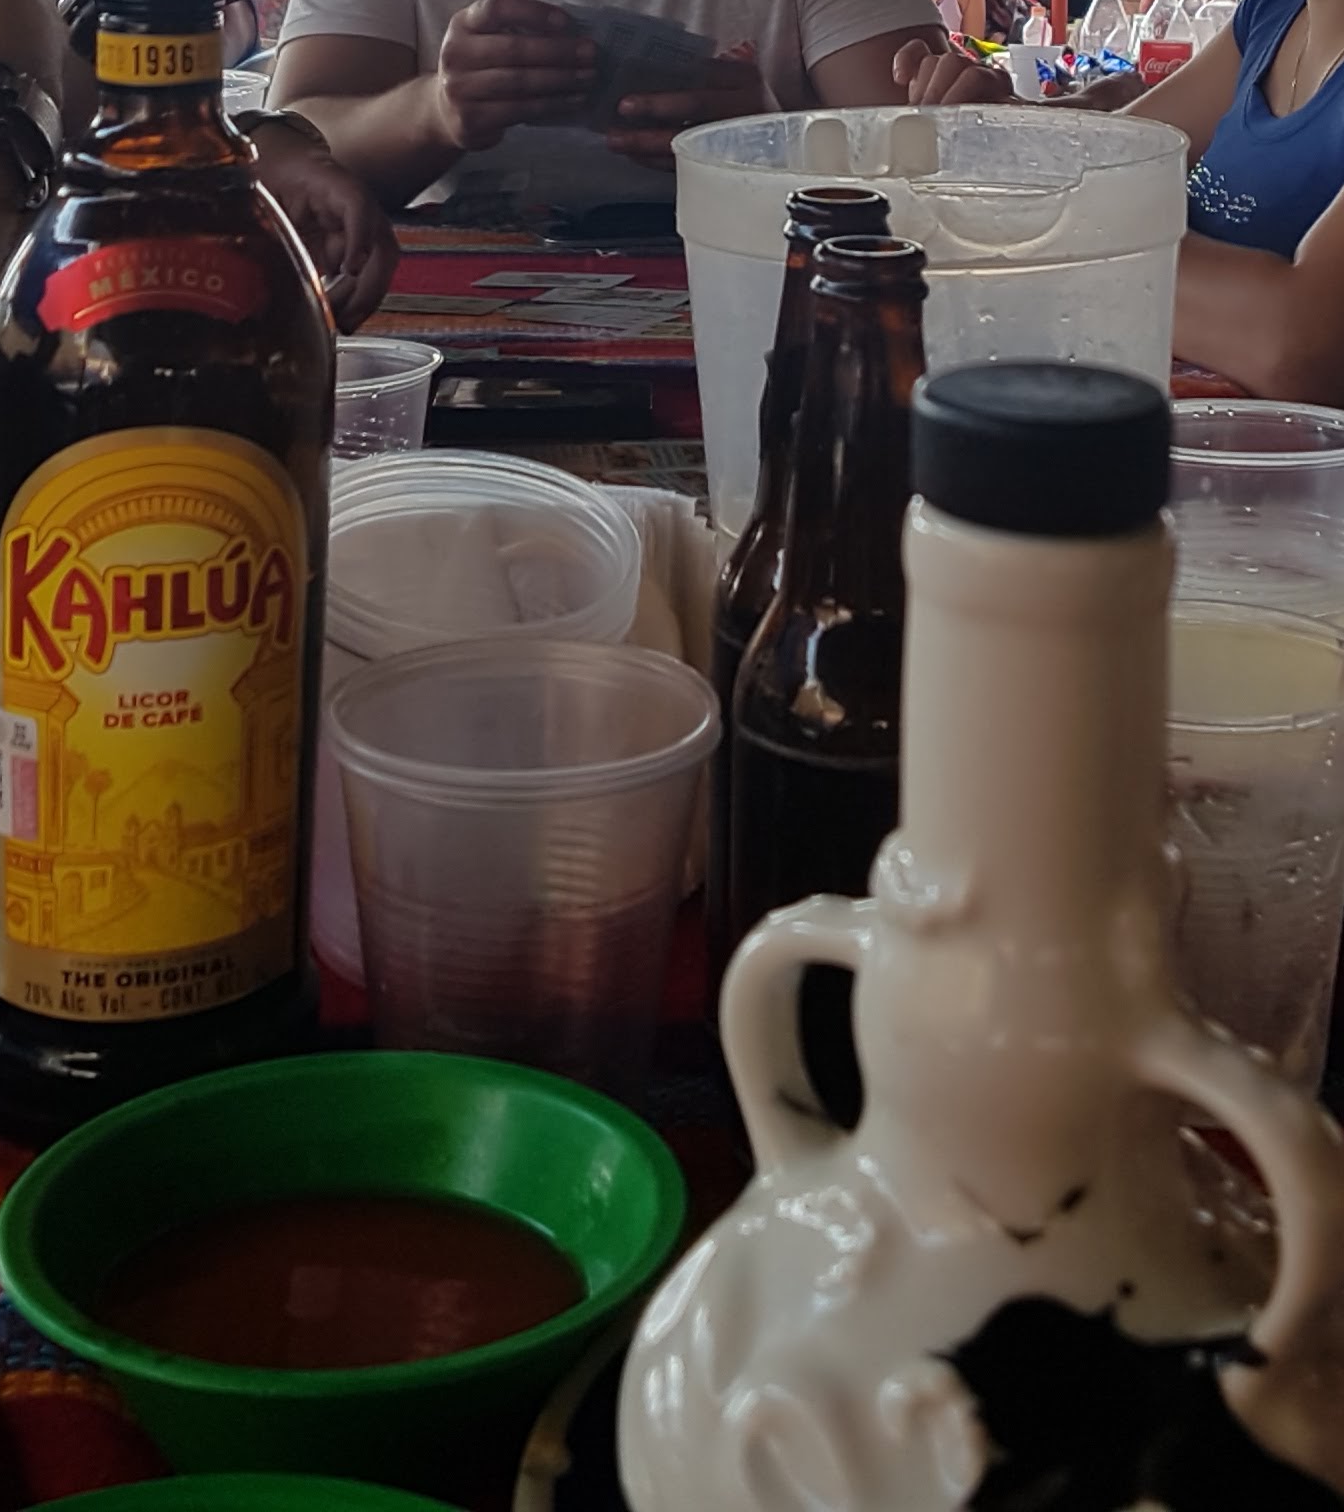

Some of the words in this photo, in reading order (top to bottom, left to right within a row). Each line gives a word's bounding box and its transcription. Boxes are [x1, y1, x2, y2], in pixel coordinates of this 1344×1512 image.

[131, 42, 194, 76] 1936
[8, 532, 294, 672] KAHLÚA
[103, 713, 134, 729] DE
[142, 702, 203, 728] CAFÉ
[117, 690, 189, 709] LICOR
[60, 969, 107, 988] THE
[115, 955, 236, 988] ORIGINAL
